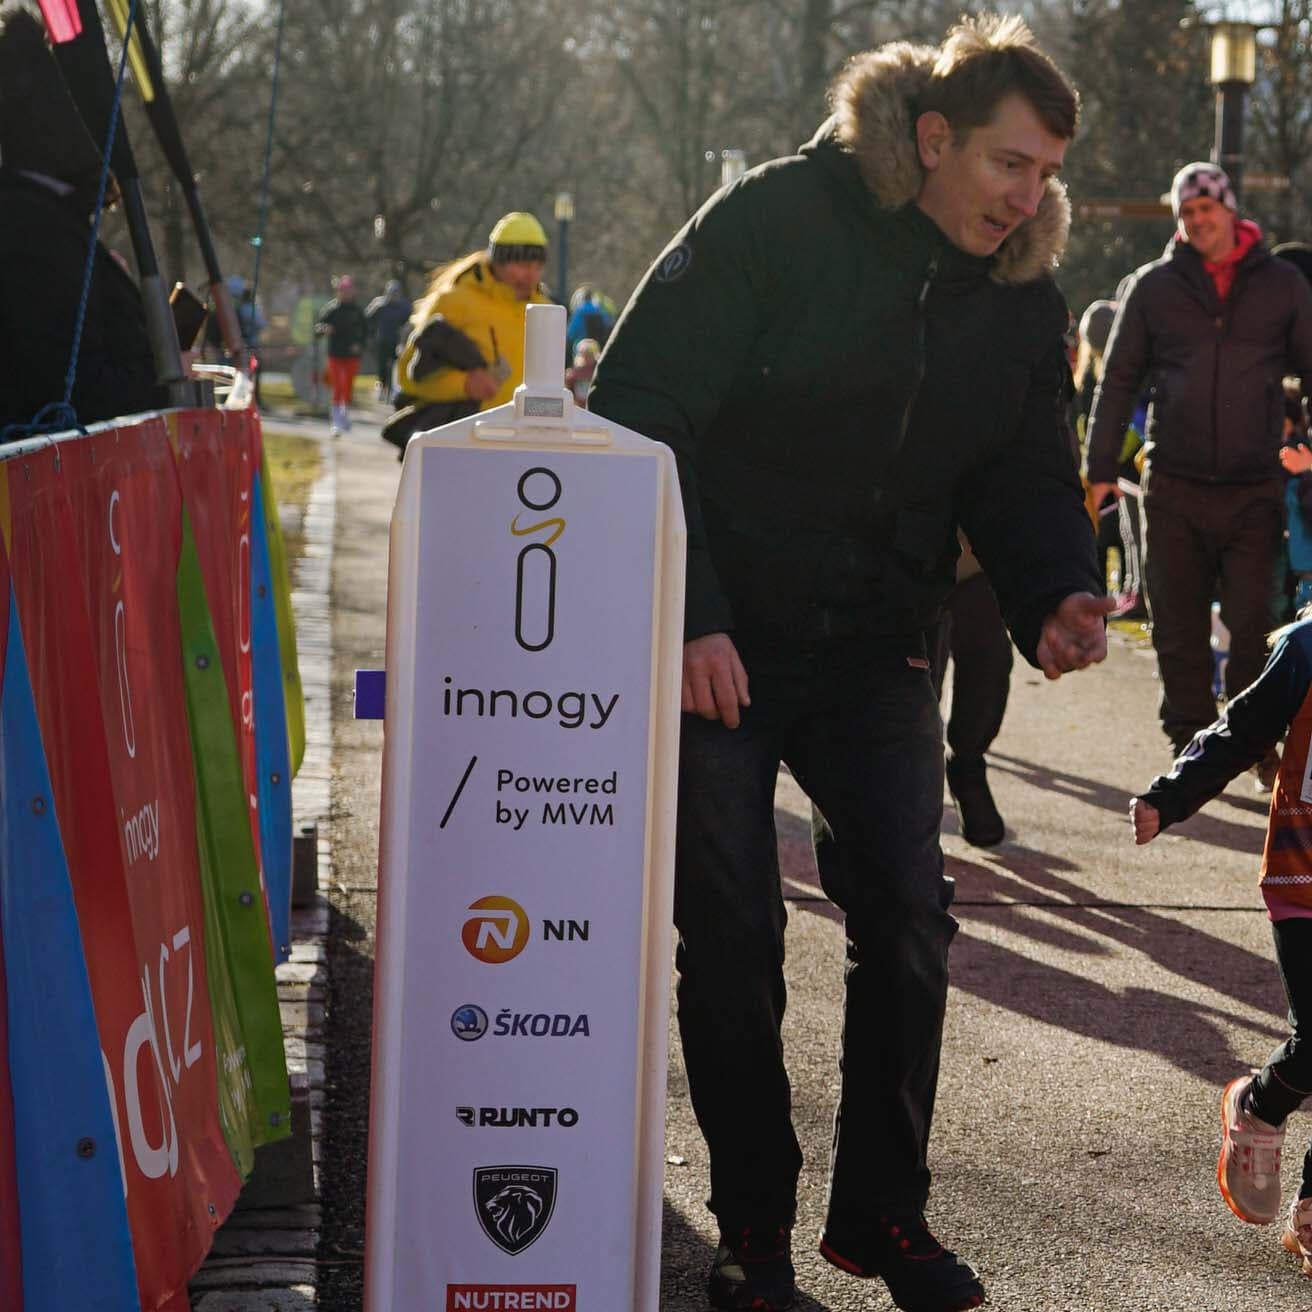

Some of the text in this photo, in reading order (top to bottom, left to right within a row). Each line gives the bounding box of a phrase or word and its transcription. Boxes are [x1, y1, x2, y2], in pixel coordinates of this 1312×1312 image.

[442, 676, 620, 729] innogy
[497, 770, 618, 795] Powered
[495, 800, 615, 830] by MVM
[542, 919, 590, 942] NN
[493, 1009, 590, 1037] ŠKODA
[479, 1107, 579, 1128] RUNTO
[481, 1173, 549, 1184] PEUGEOT
[453, 1291, 570, 1310] NUTREND
